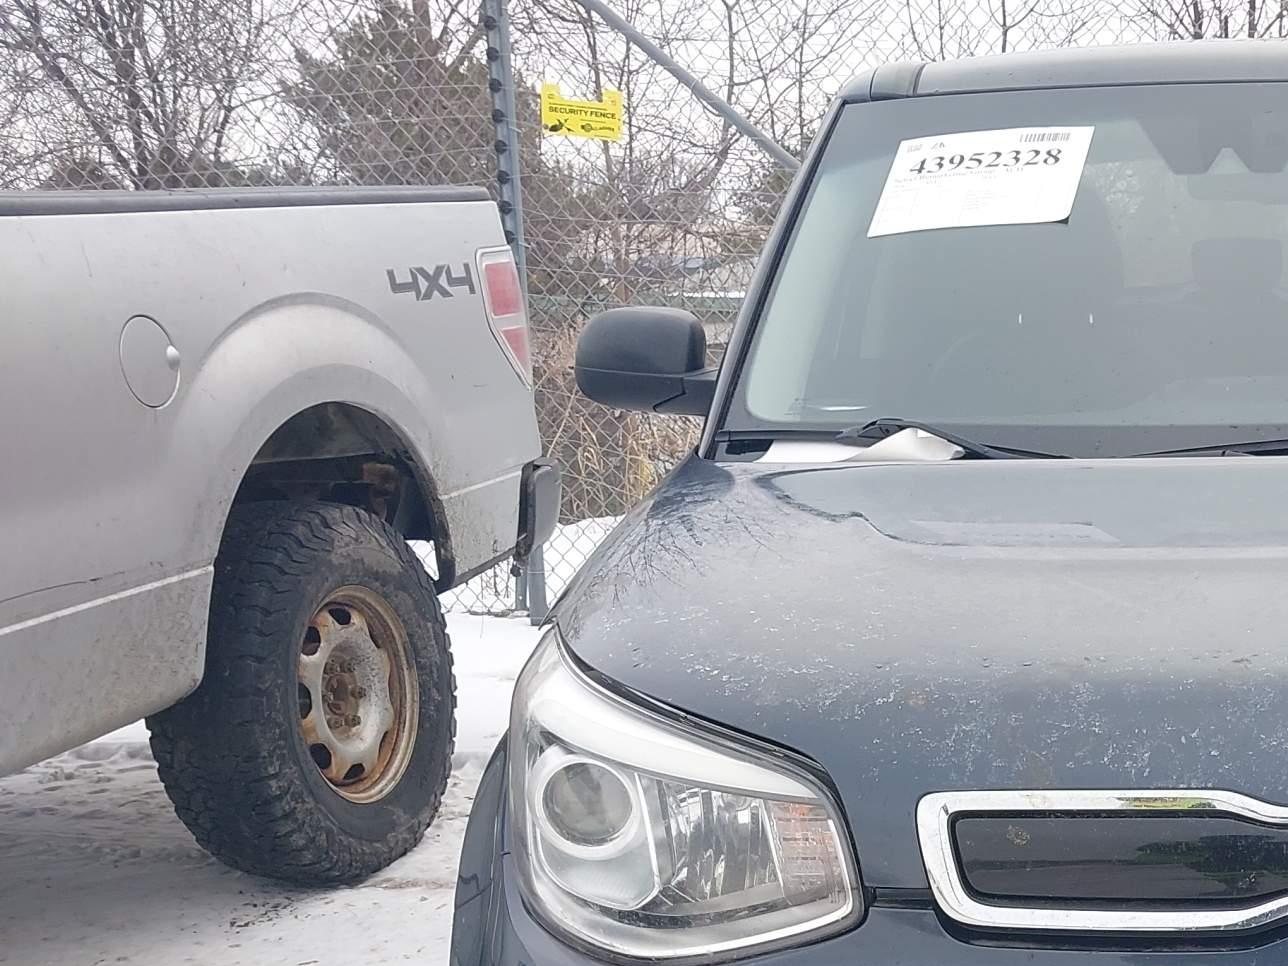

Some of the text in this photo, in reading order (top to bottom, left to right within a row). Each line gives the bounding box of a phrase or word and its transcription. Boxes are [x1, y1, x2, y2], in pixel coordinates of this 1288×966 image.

[548, 106, 617, 120] SECURITY FENCE
[909, 147, 1063, 175] 43952328
